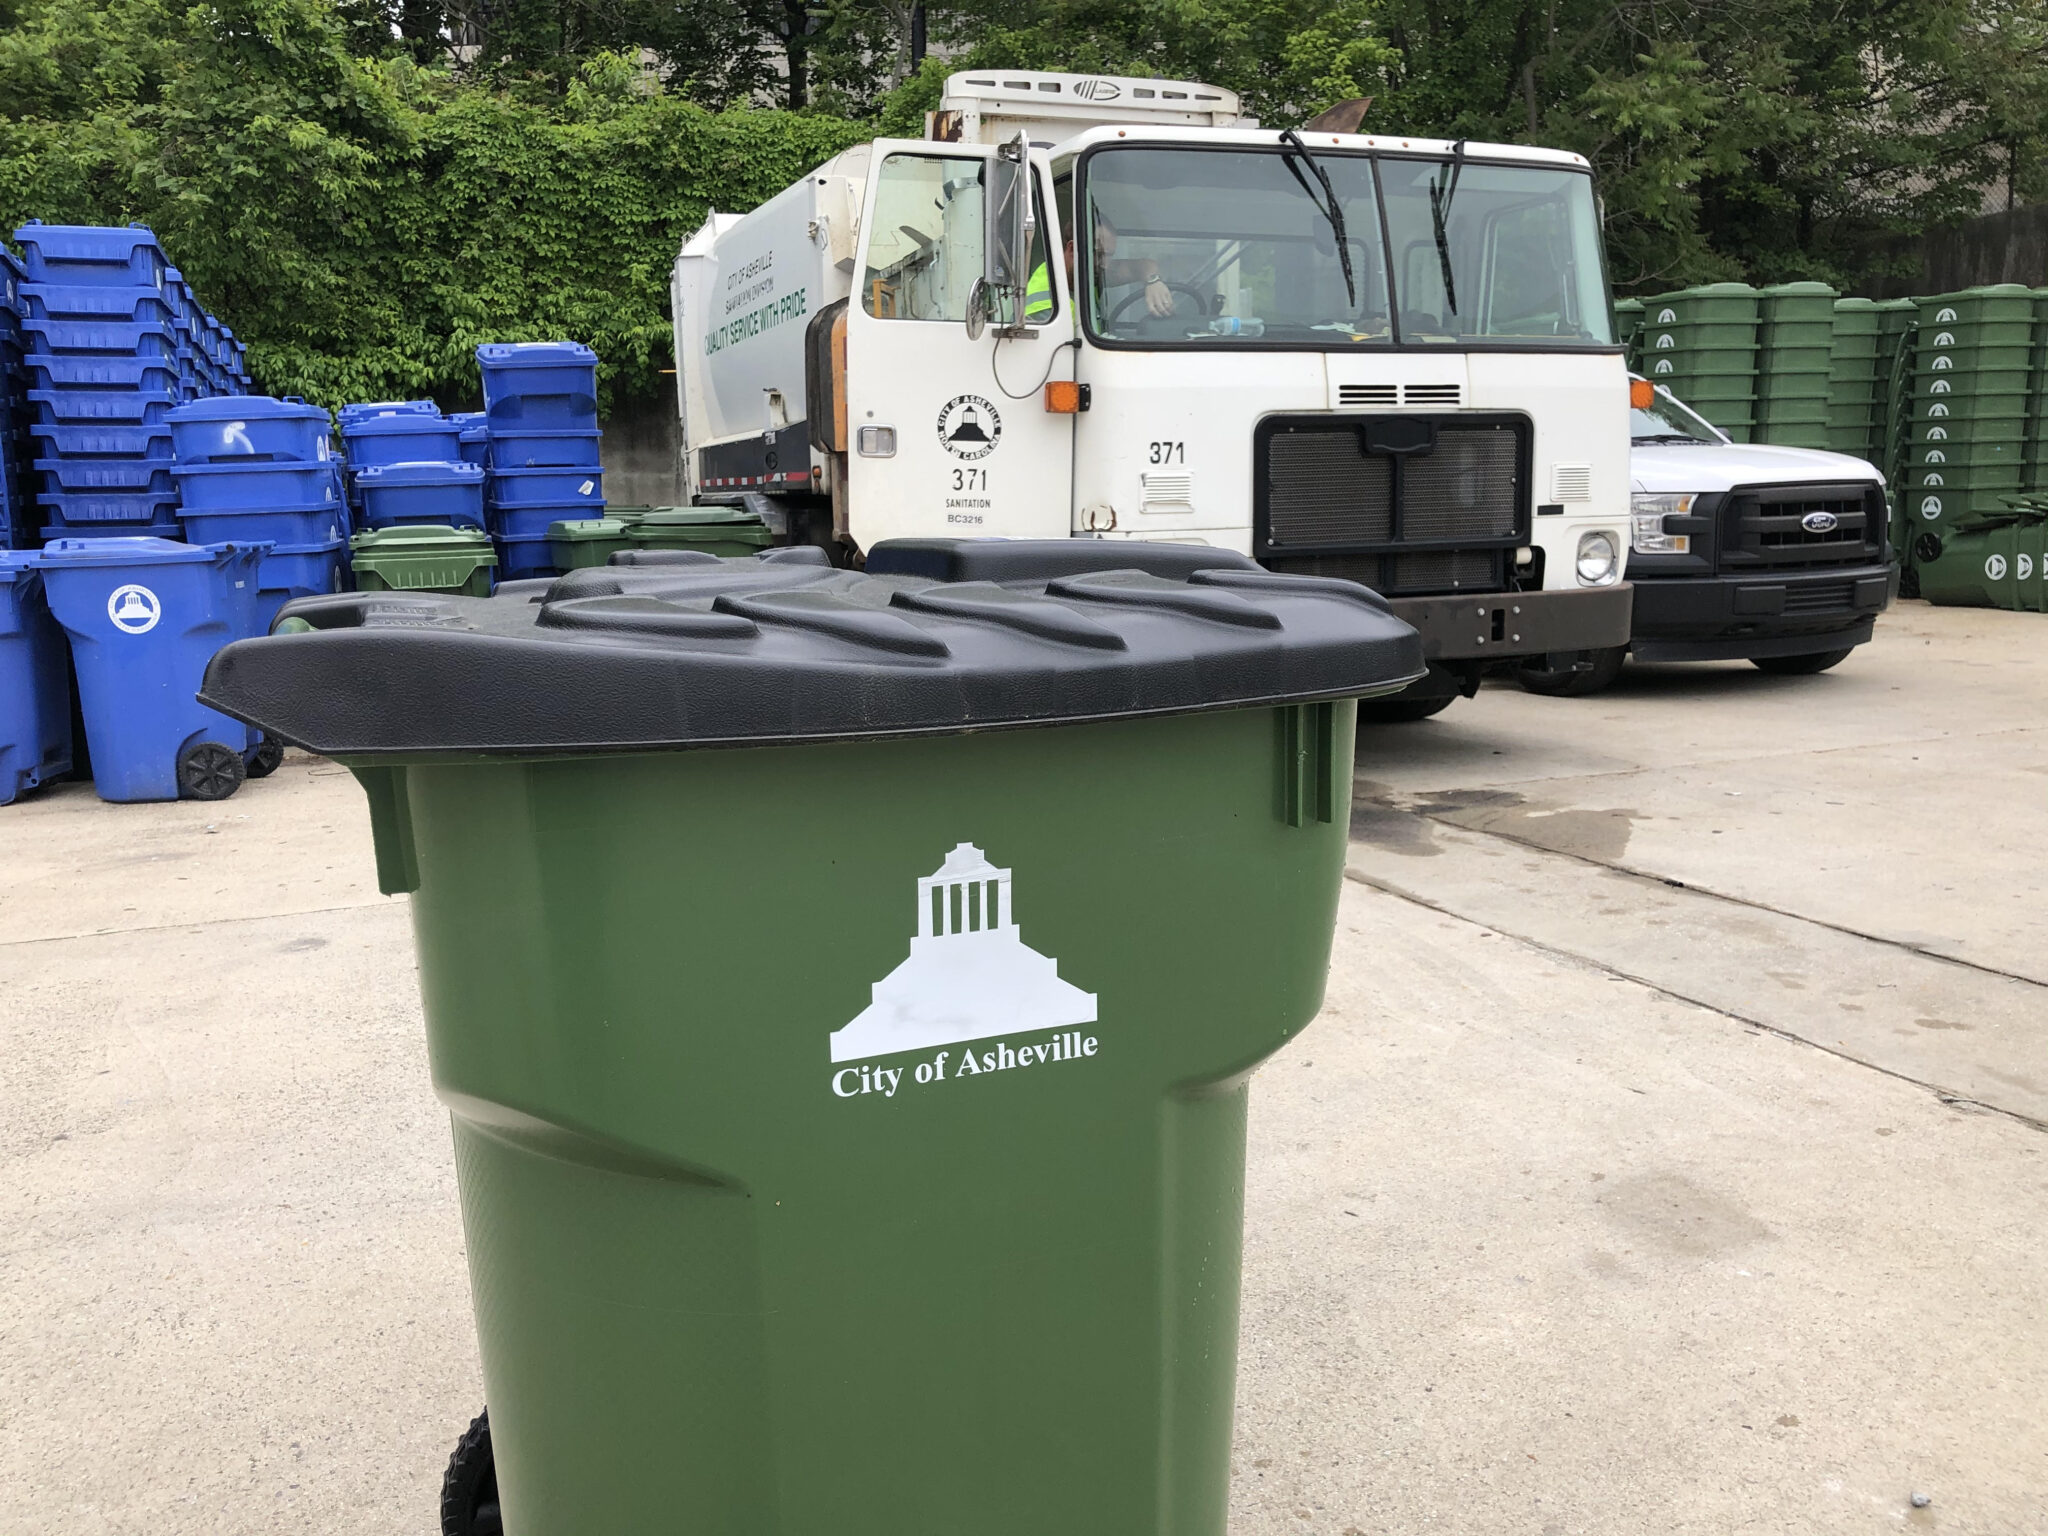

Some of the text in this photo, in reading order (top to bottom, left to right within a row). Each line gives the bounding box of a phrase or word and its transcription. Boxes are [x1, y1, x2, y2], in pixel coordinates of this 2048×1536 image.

[727, 250, 773, 290] CITY OF ASHEVILLE
[704, 288, 807, 356] QUALITY SERVICE WITH PRIDE
[937, 395, 1002, 428] CITY OF ASHEVILLE
[937, 431, 1001, 461] NORTH CAROLINA
[1150, 441, 1184, 464] 371
[952, 468, 986, 491] 371
[945, 498, 991, 509] SANITATION
[947, 514, 983, 525] BC3216
[831, 1031, 1098, 1098] City of Asheville
